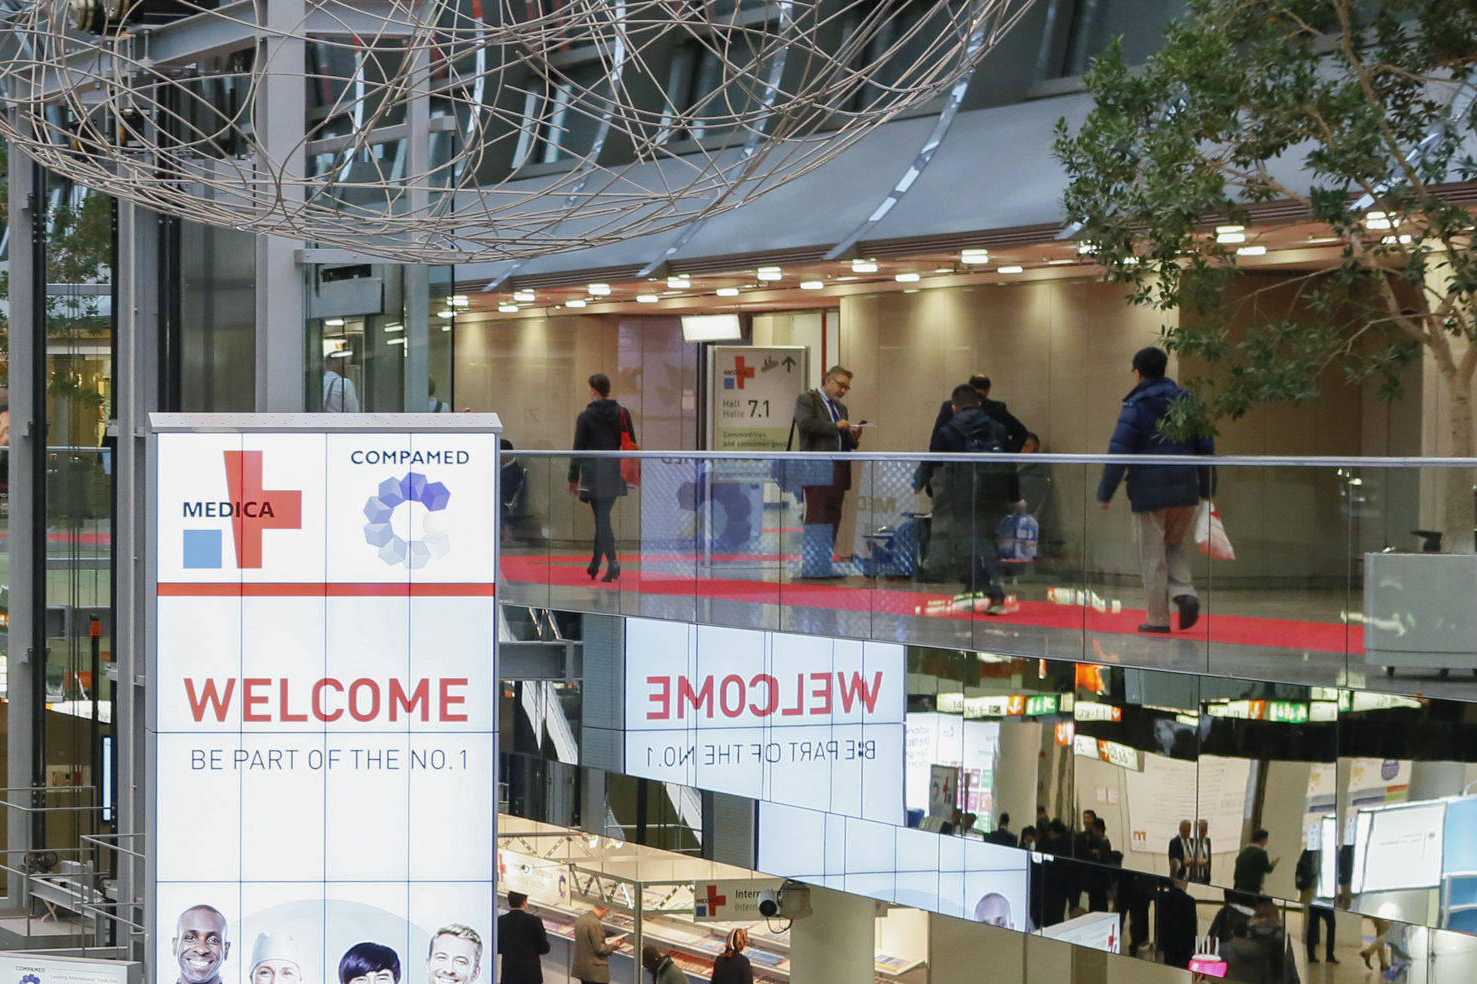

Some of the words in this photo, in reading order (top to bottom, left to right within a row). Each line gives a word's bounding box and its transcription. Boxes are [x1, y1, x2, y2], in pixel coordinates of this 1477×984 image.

[748, 400, 770, 418] 7.1
[351, 451, 470, 465] COMPAMED
[183, 502, 275, 518] MEDICA
[183, 678, 468, 722] WELCOME
[192, 750, 224, 770] BE
[234, 750, 299, 770] PART
[308, 750, 341, 770] OF
[351, 750, 400, 770] THE
